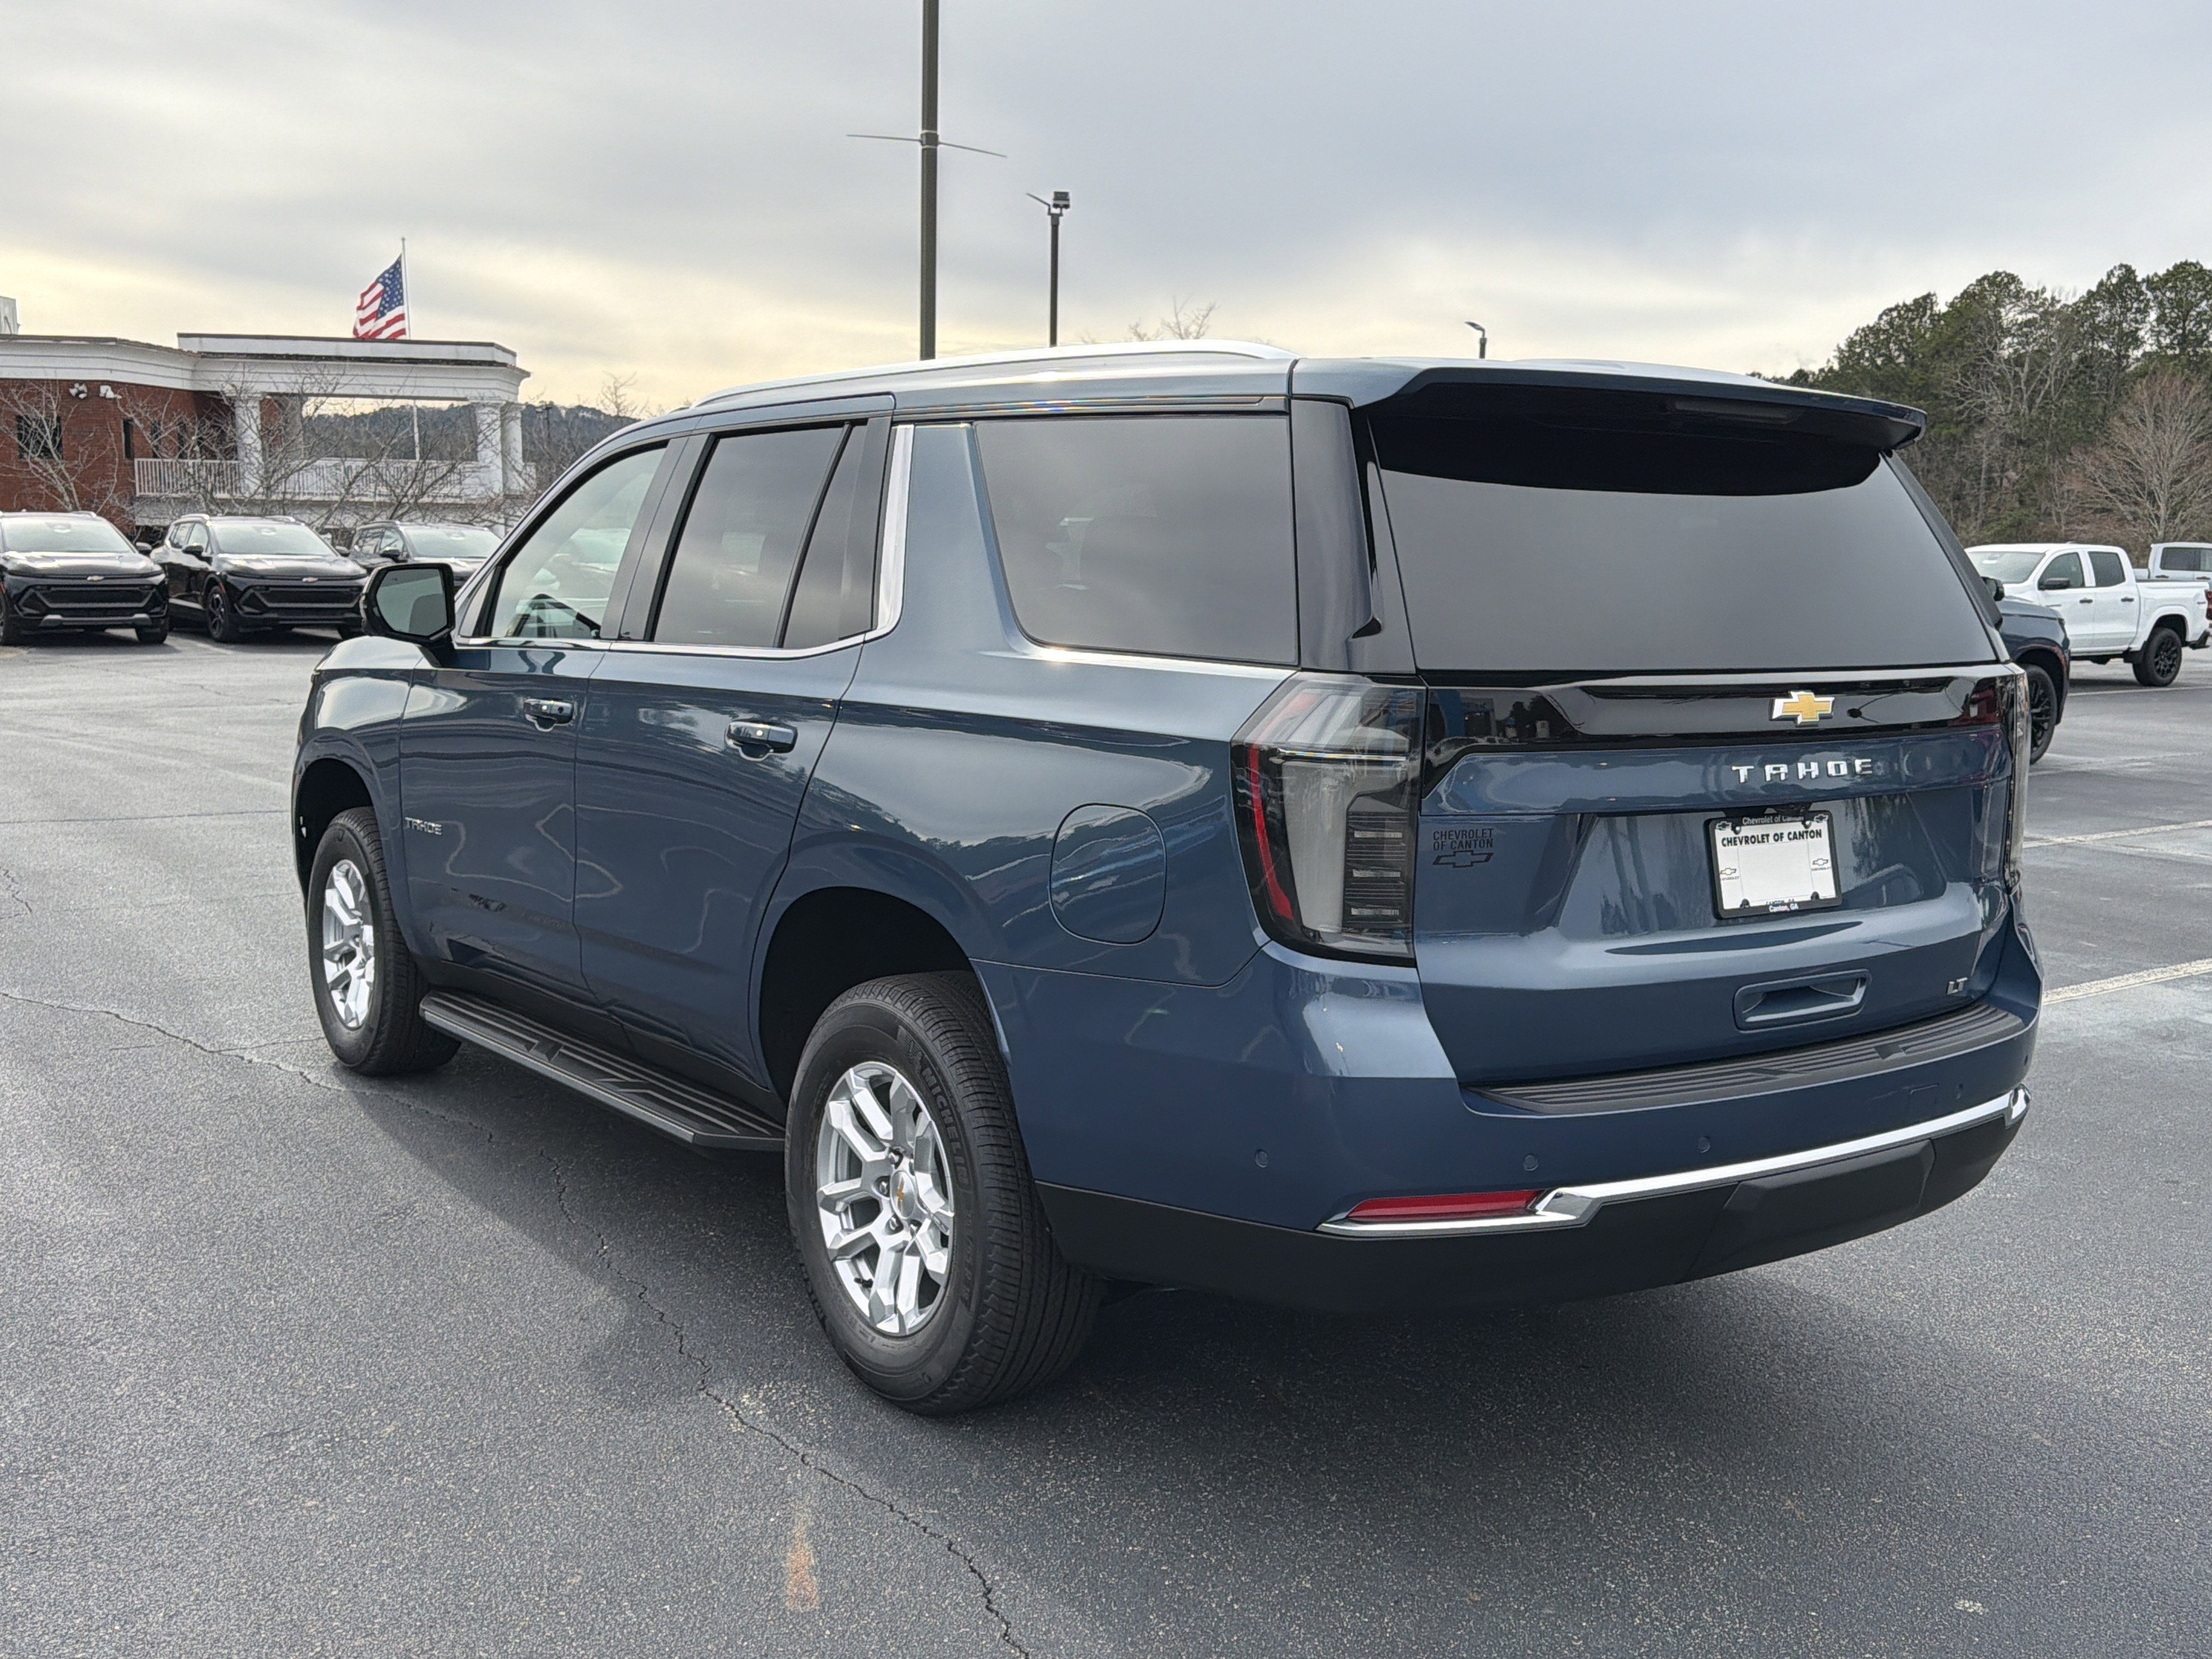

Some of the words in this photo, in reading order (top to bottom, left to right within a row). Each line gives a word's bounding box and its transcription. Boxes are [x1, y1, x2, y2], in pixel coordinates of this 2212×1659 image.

[1731, 759, 1873, 783] TAHOE
[405, 817, 442, 835] TAHOE
[1742, 816, 1773, 825] Chevrolet
[1774, 814, 1781, 822] of
[1433, 828, 1494, 840] CHEVROLET
[1722, 833, 1769, 847] CHEVROLET
[1773, 833, 1784, 842] OF
[1787, 829, 1822, 840] CANTON
[1433, 841, 1447, 850] OF
[1451, 838, 1493, 850] CANTON
[1947, 977, 1968, 995] LT
[922, 1067, 969, 1186] MICHELIN
